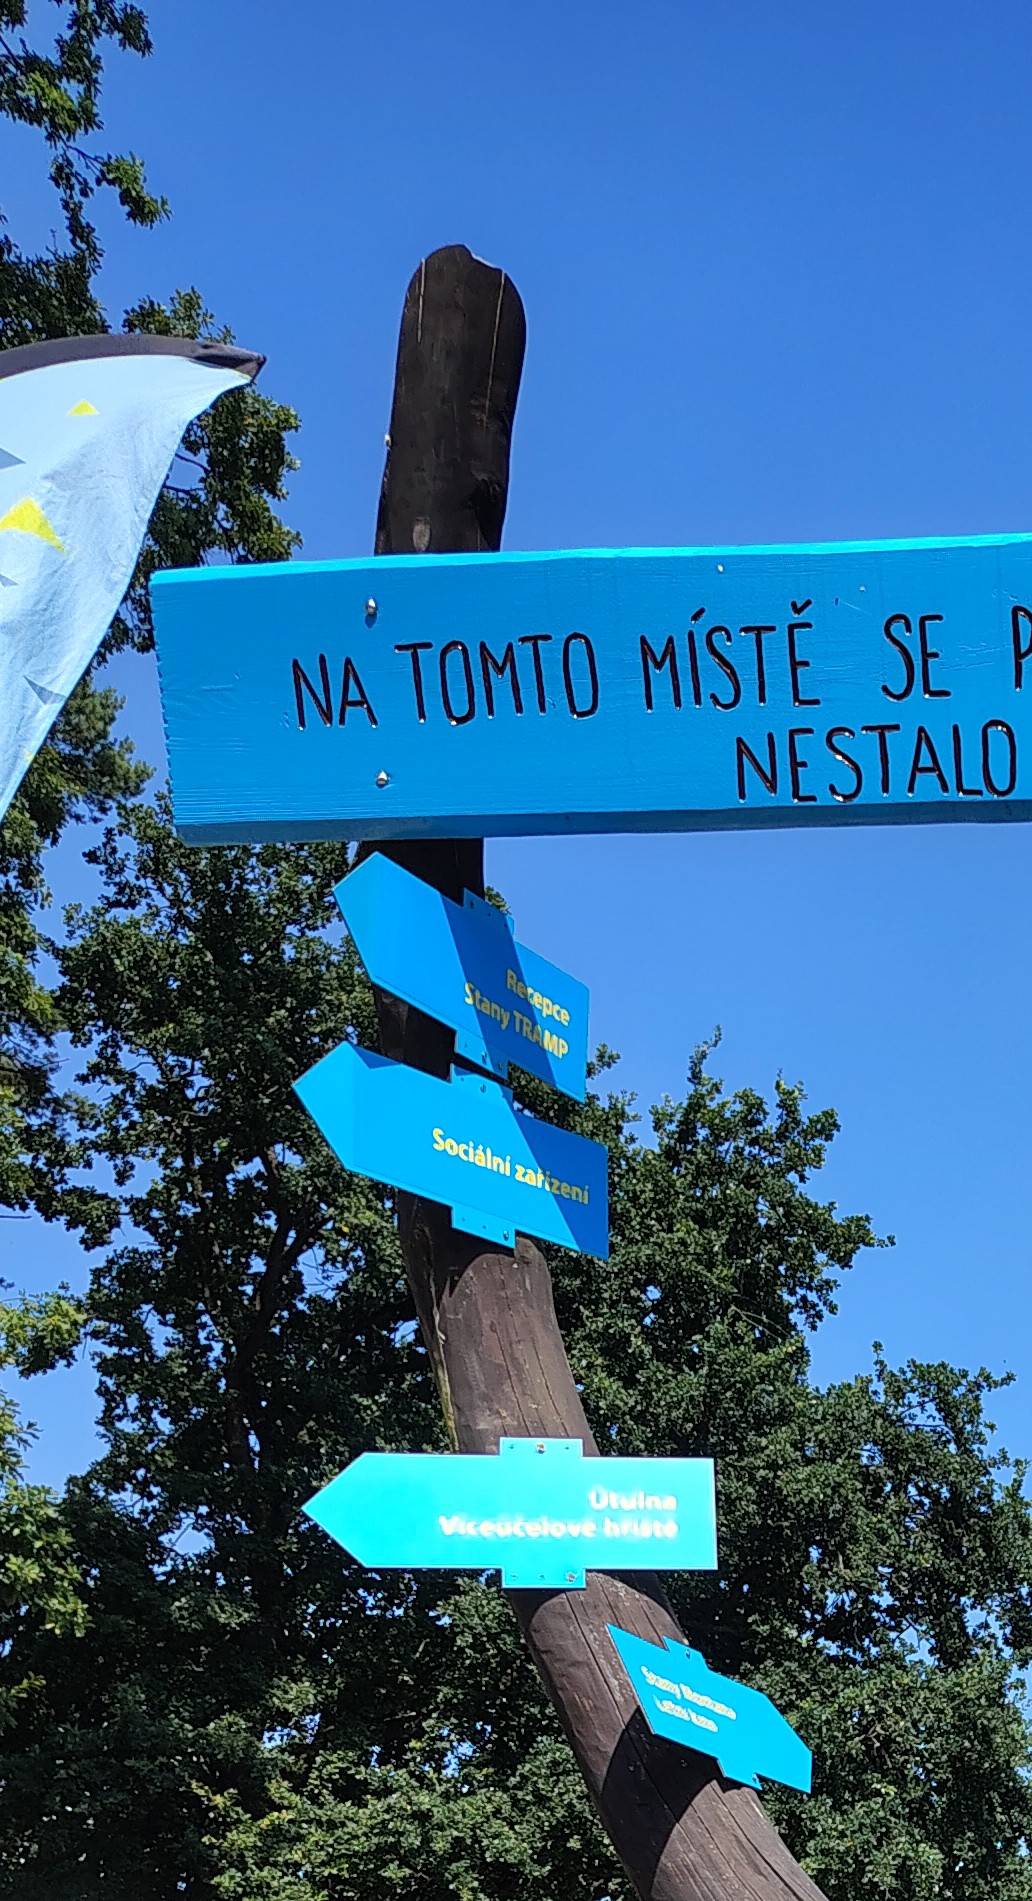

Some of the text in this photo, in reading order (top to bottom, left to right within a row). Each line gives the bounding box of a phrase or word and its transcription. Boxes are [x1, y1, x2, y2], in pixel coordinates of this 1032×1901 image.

[291, 654, 378, 731] NA
[394, 630, 600, 727] TOMTO
[640, 599, 823, 714] MÍSTĚ
[880, 611, 953, 702] SE
[735, 720, 1018, 804] NESTALO
[464, 981, 569, 1060] Stany TRAMP
[506, 967, 571, 1027] Recepce
[431, 1127, 591, 1206] Sociální zařízení
